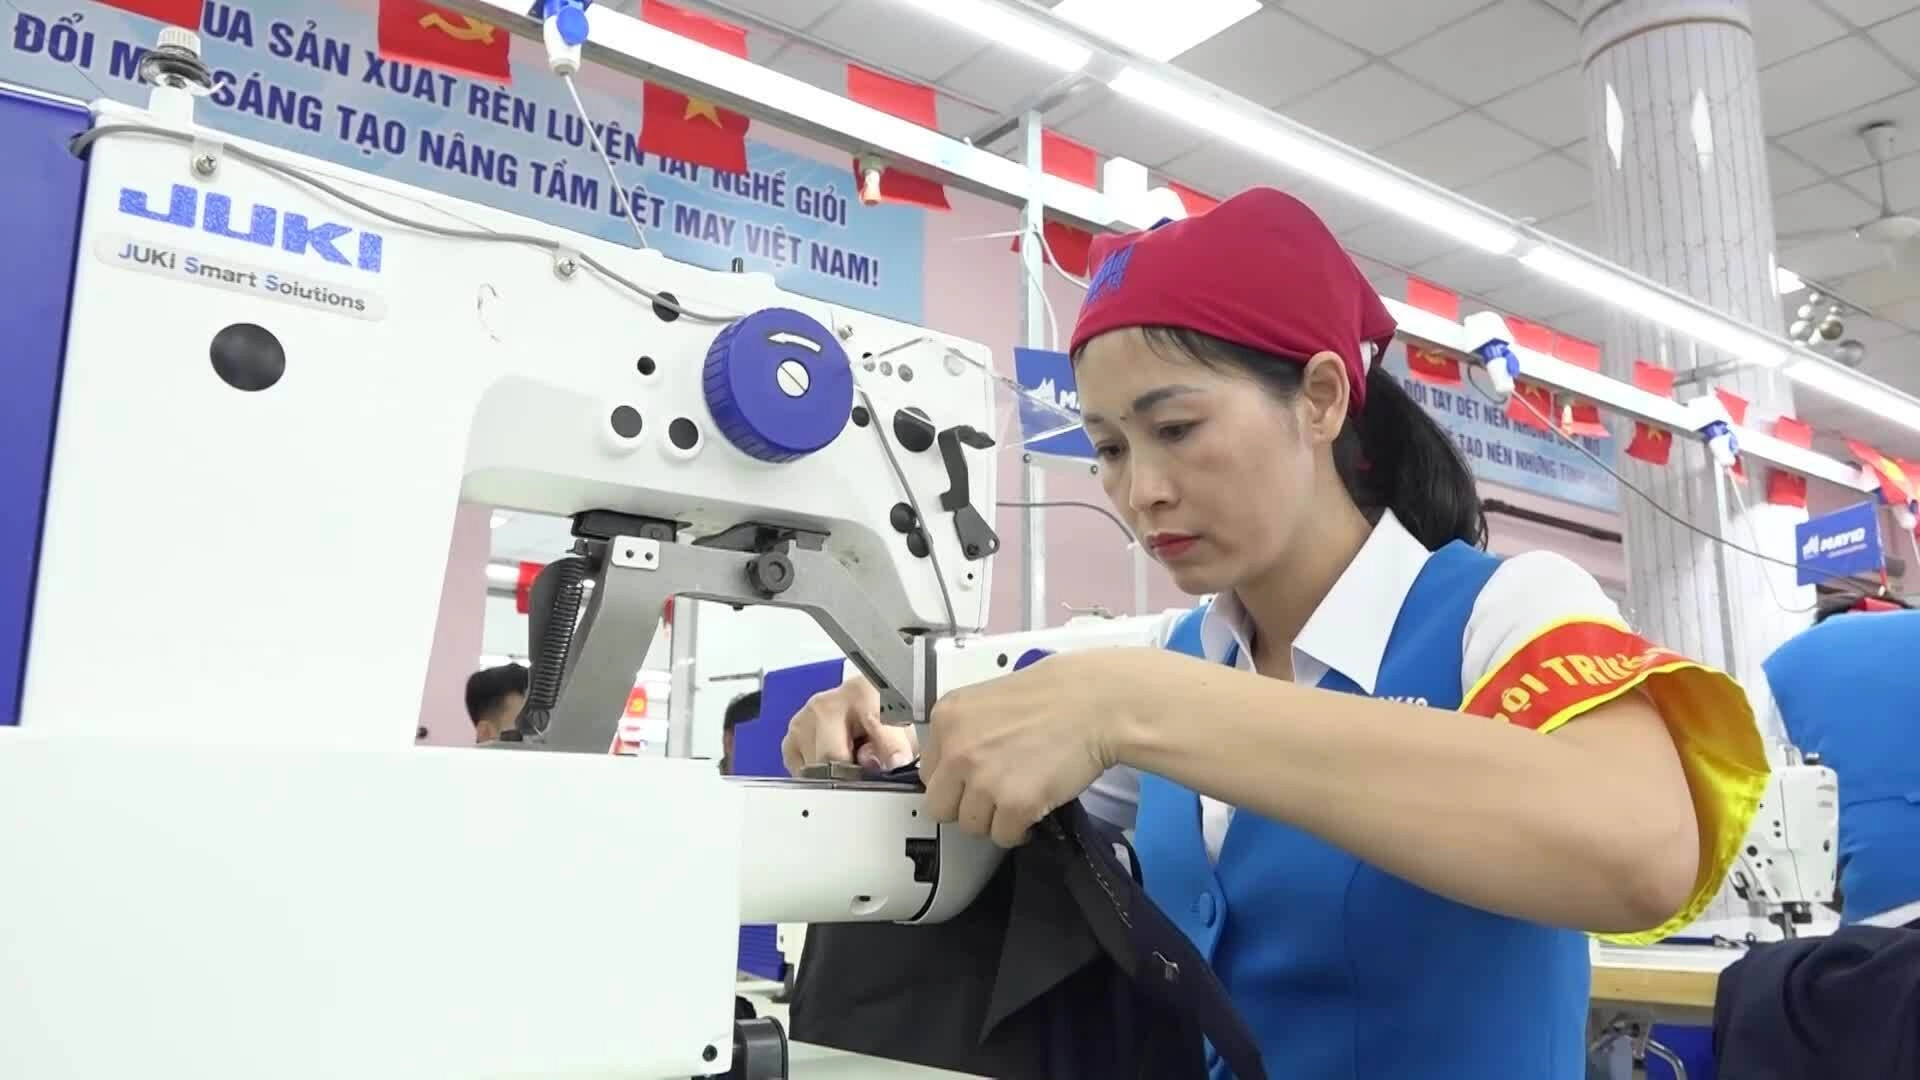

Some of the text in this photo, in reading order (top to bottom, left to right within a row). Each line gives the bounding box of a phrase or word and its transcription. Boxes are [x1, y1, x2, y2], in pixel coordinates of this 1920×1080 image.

[14, 12, 94, 69] ĐỔI
[211, 69, 323, 133] SÁNG
[337, 104, 406, 155] TẠO
[419, 130, 518, 188] NÂNG
[530, 157, 599, 211] TẨM
[609, 183, 665, 229] DỆT
[674, 204, 737, 247] MAY
[744, 224, 802, 268] VIỆT
[811, 241, 878, 287] NAM!
[202, 0, 253, 48] UA
[269, 19, 351, 77] SẢN
[468, 83, 536, 133] RÈN
[547, 108, 645, 166] LUYỆN
[795, 185, 847, 226] GIỎI
[118, 183, 383, 273] JUKI
[118, 243, 366, 312] JUKI Smart Solutions
[1493, 673, 1549, 724] ỘI
